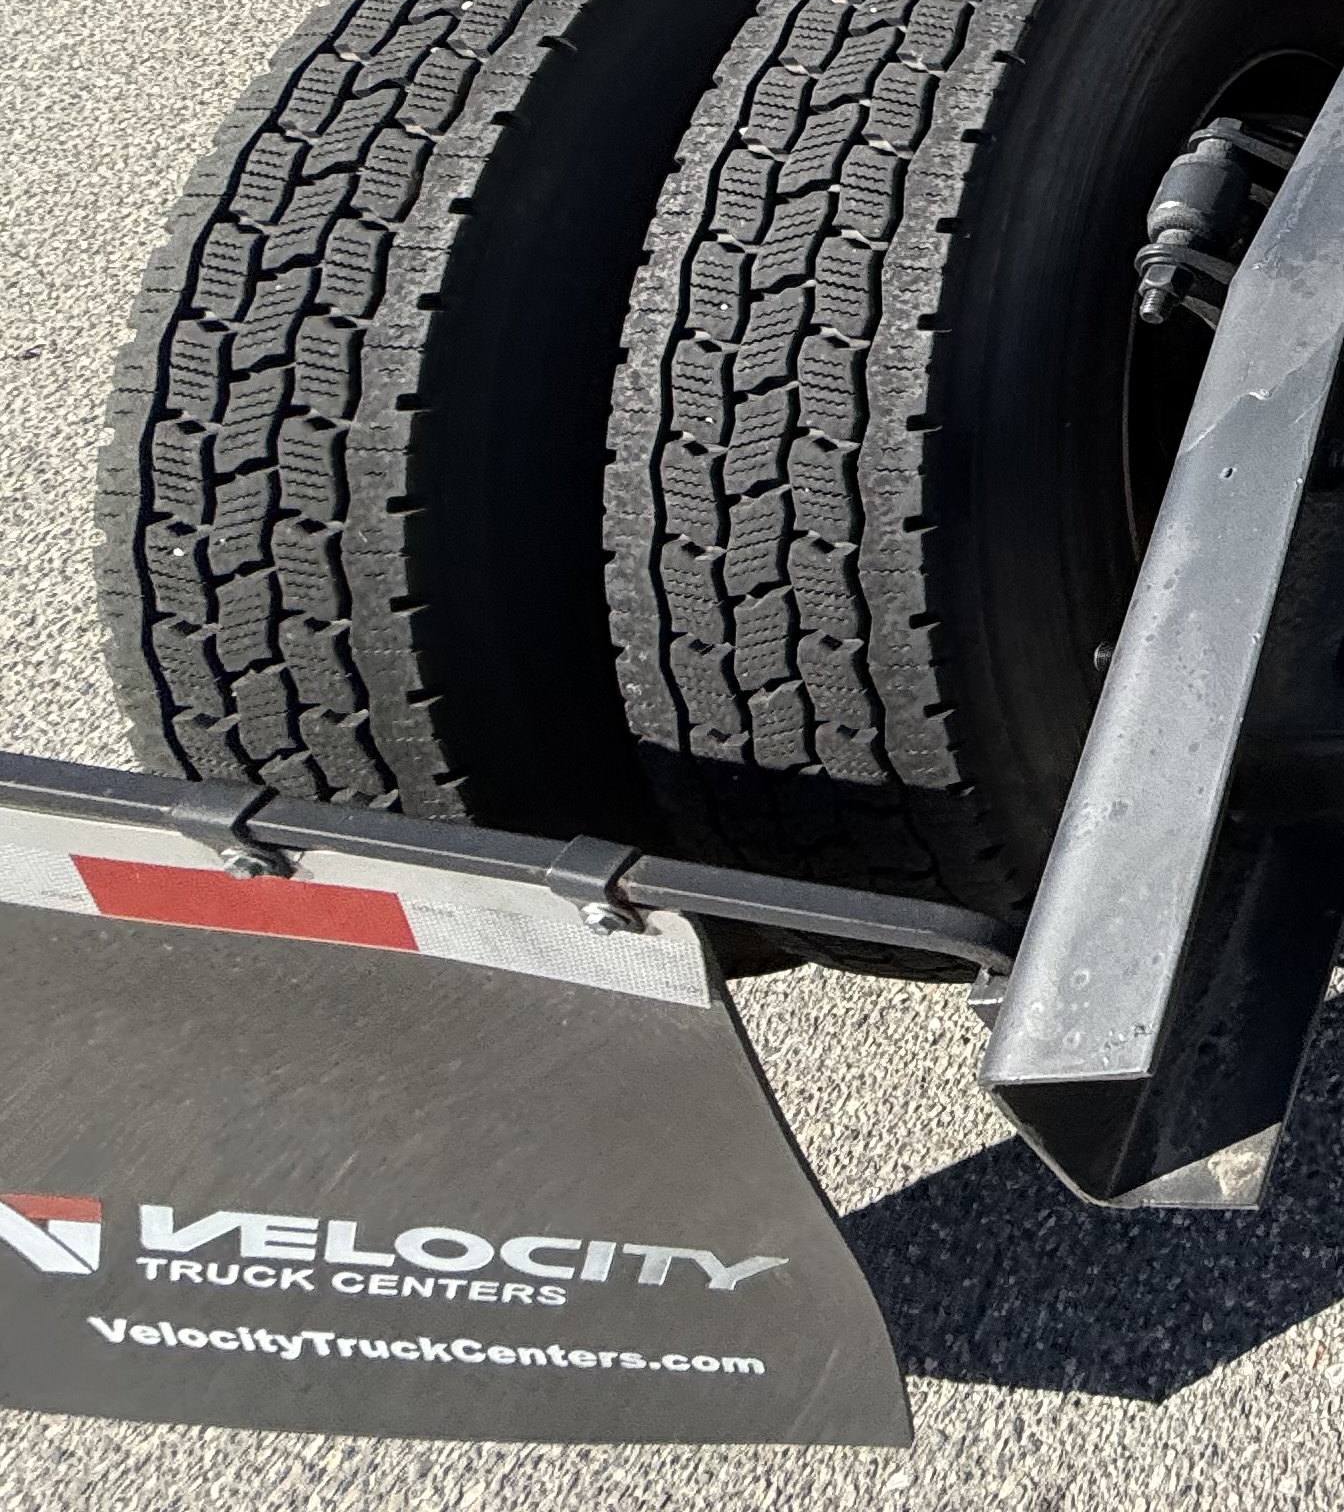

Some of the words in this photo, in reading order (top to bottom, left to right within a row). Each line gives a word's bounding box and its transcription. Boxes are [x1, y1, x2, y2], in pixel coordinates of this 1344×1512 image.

[138, 1203, 790, 1291] VELOCITY
[135, 1256, 315, 1292] TRUCK
[331, 1270, 568, 1306] CENTERS
[86, 1314, 767, 1376] VelocityTruckCenters.com
